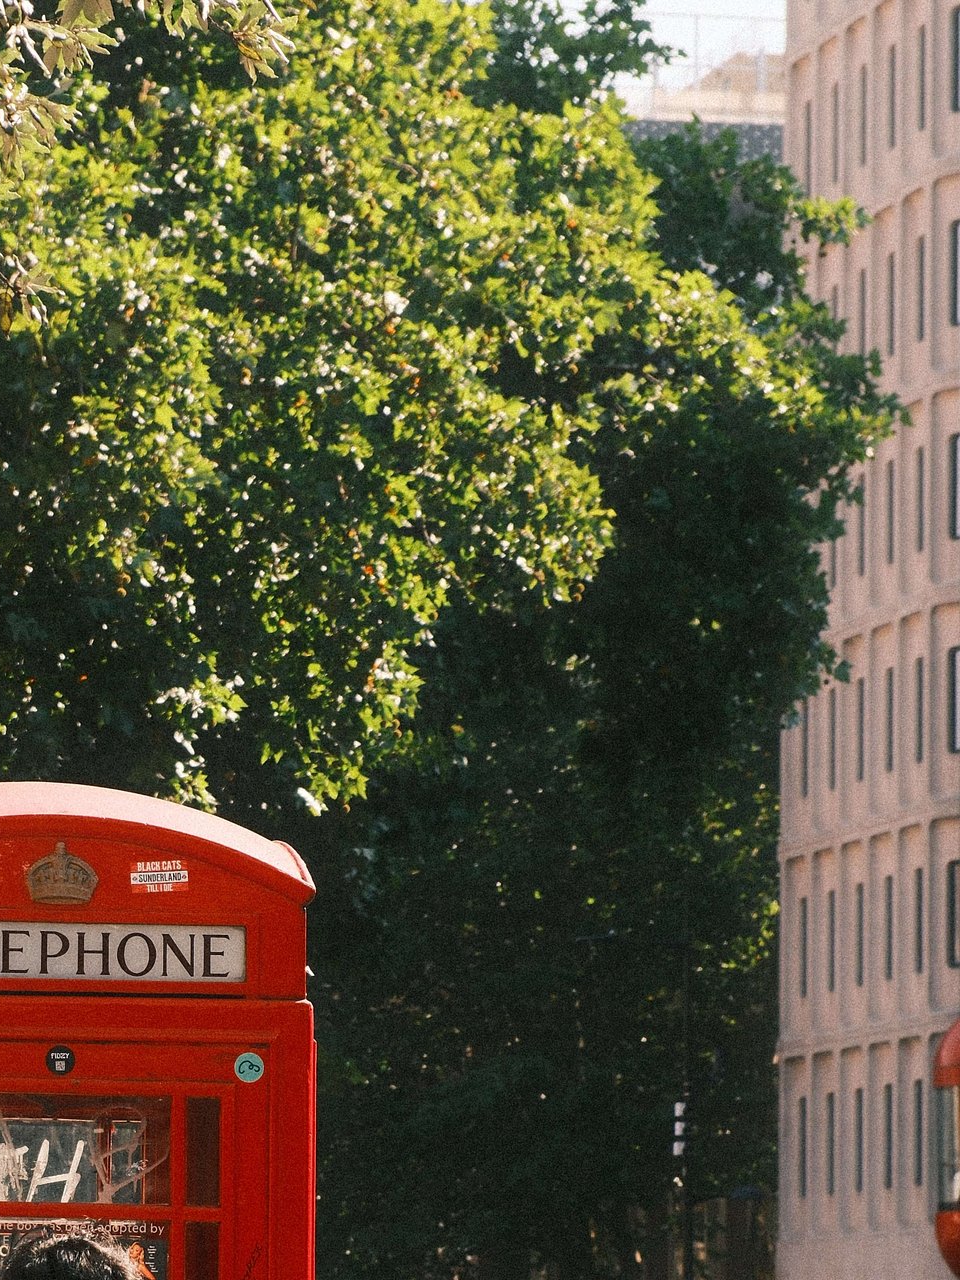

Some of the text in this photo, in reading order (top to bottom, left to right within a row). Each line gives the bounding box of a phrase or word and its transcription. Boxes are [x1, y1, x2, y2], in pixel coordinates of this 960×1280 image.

[137, 860, 182, 872] BLACK CATS
[138, 872, 182, 883] SUNDERLAND
[146, 885, 159, 893] TILL
[163, 884, 173, 892] DIE
[150, 1223, 165, 1236] by
